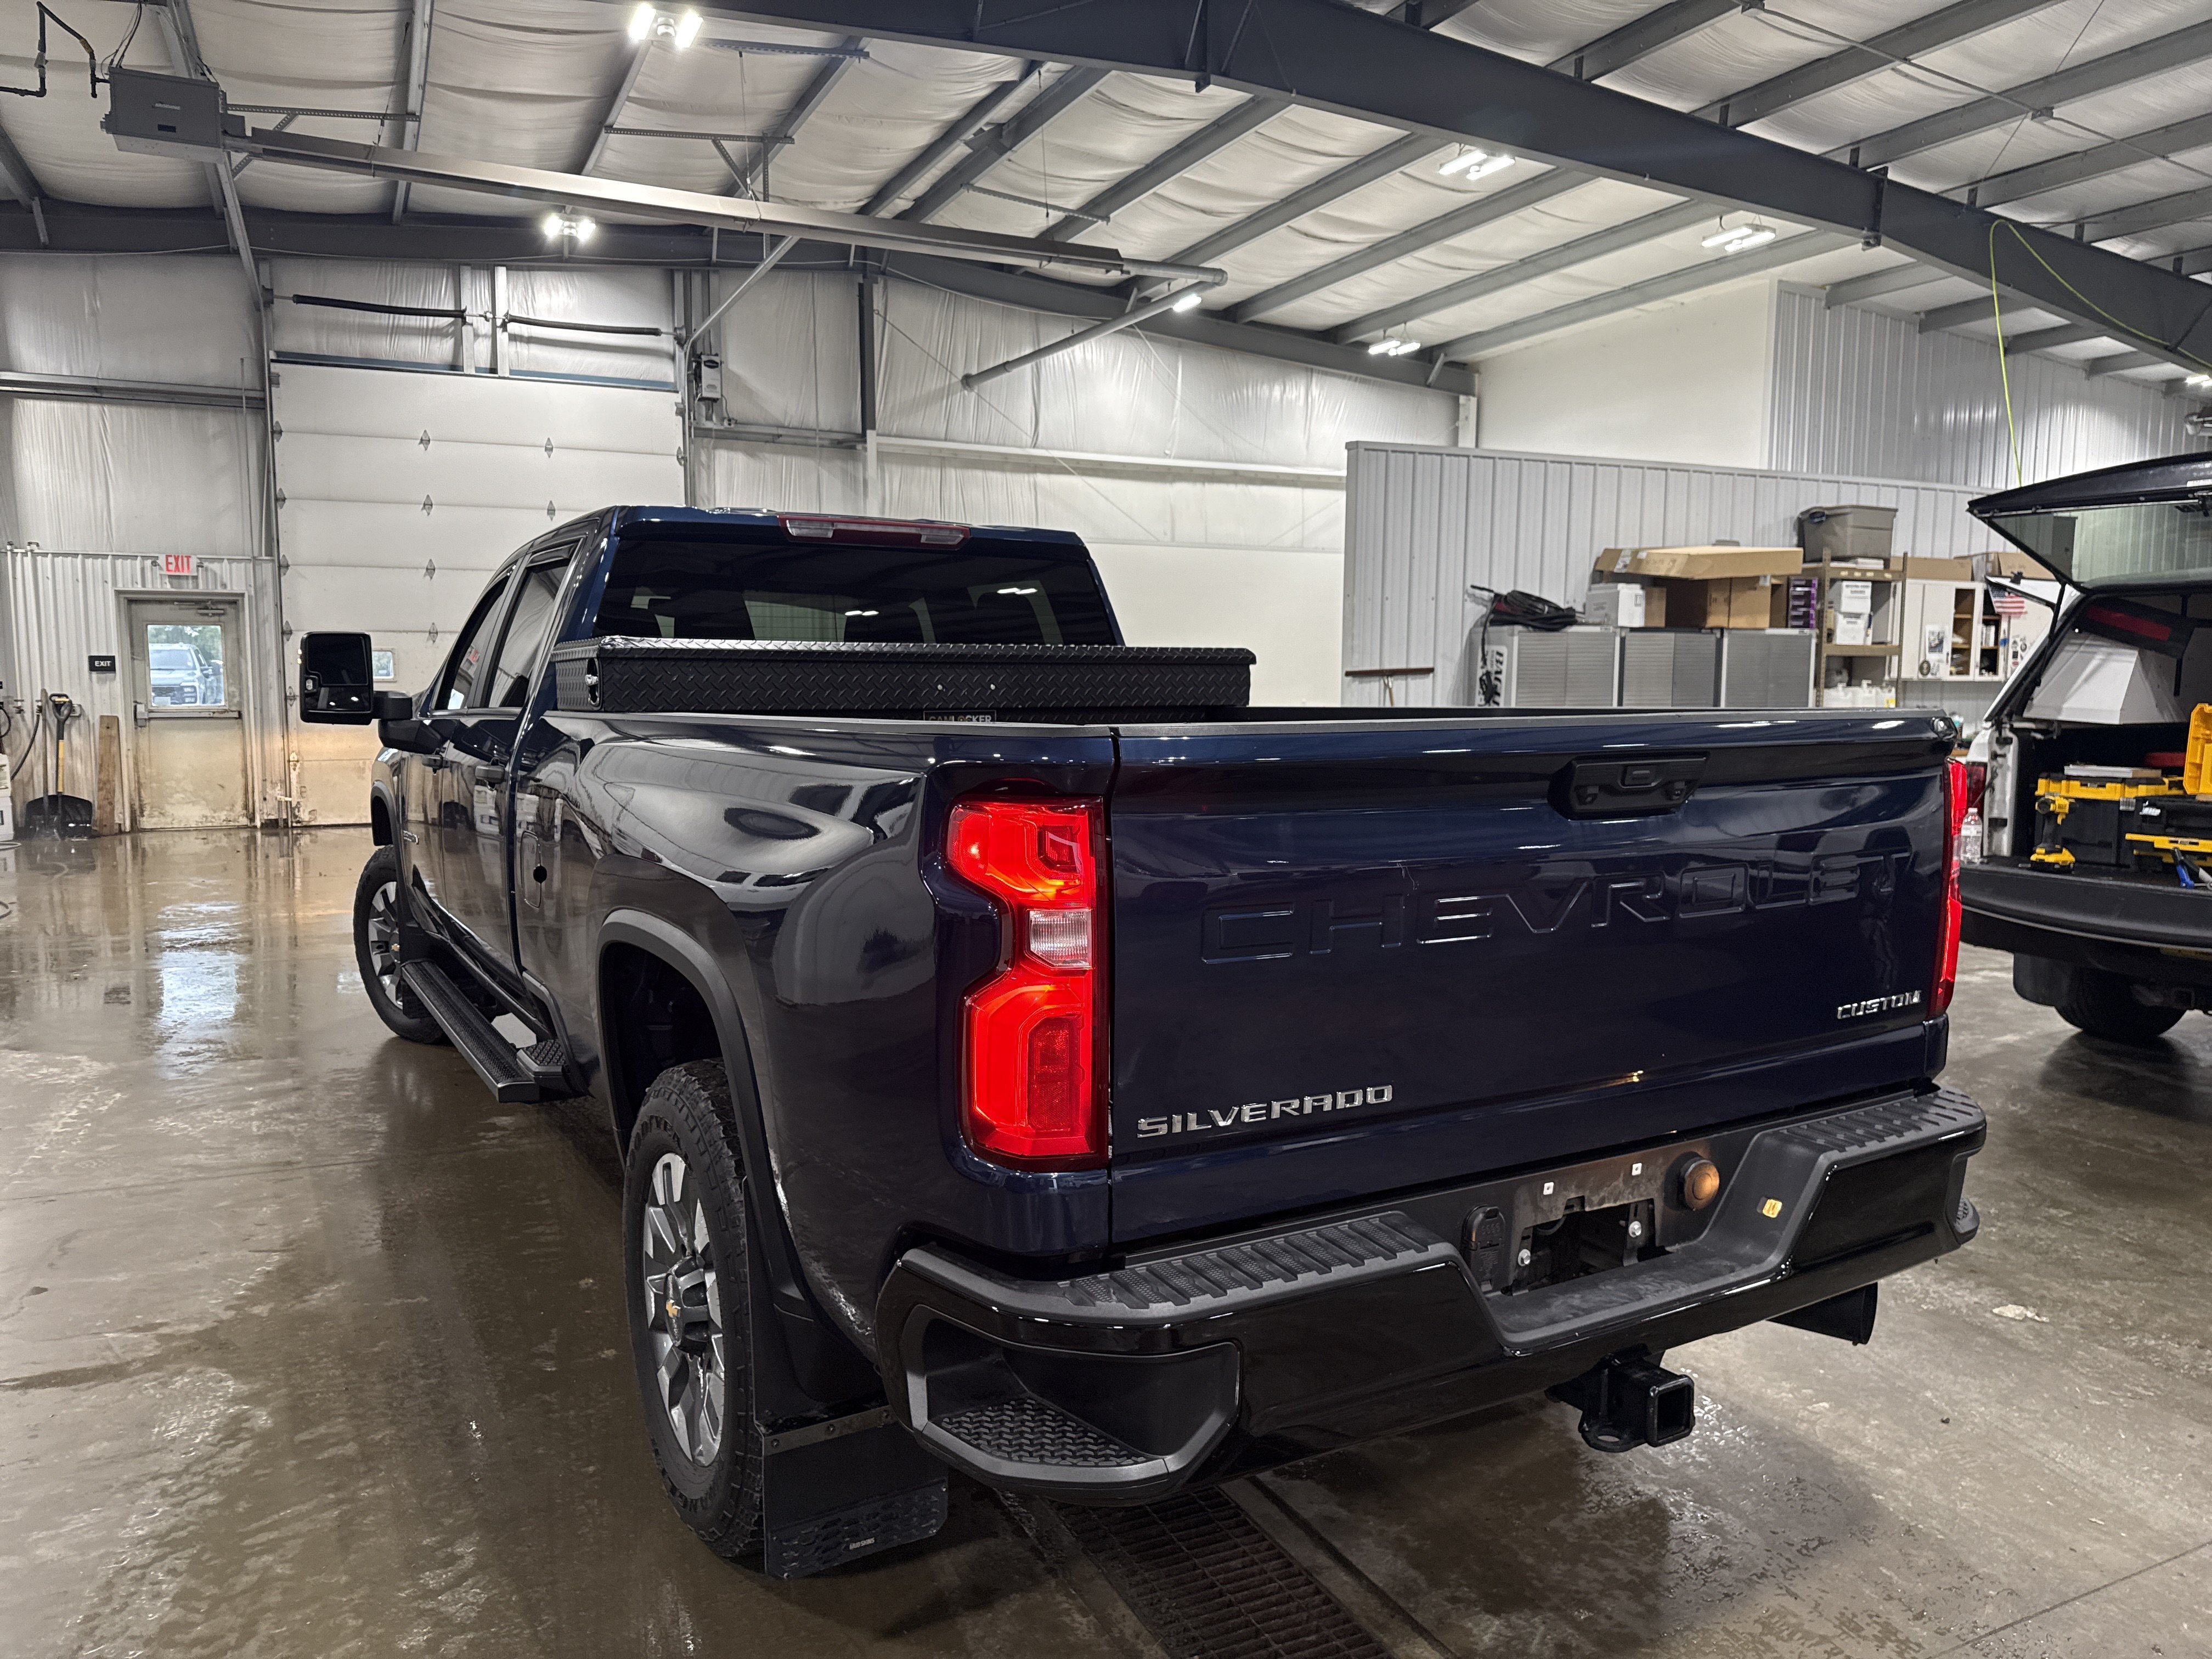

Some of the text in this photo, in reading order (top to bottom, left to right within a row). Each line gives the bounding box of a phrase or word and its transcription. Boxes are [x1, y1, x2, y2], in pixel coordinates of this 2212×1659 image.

[165, 554, 191, 573] EXIT
[1201, 852, 1911, 964] CHEVROLET
[1837, 990, 1922, 1019] CUSTOM
[1137, 1085, 1392, 1138] SILVERADO
